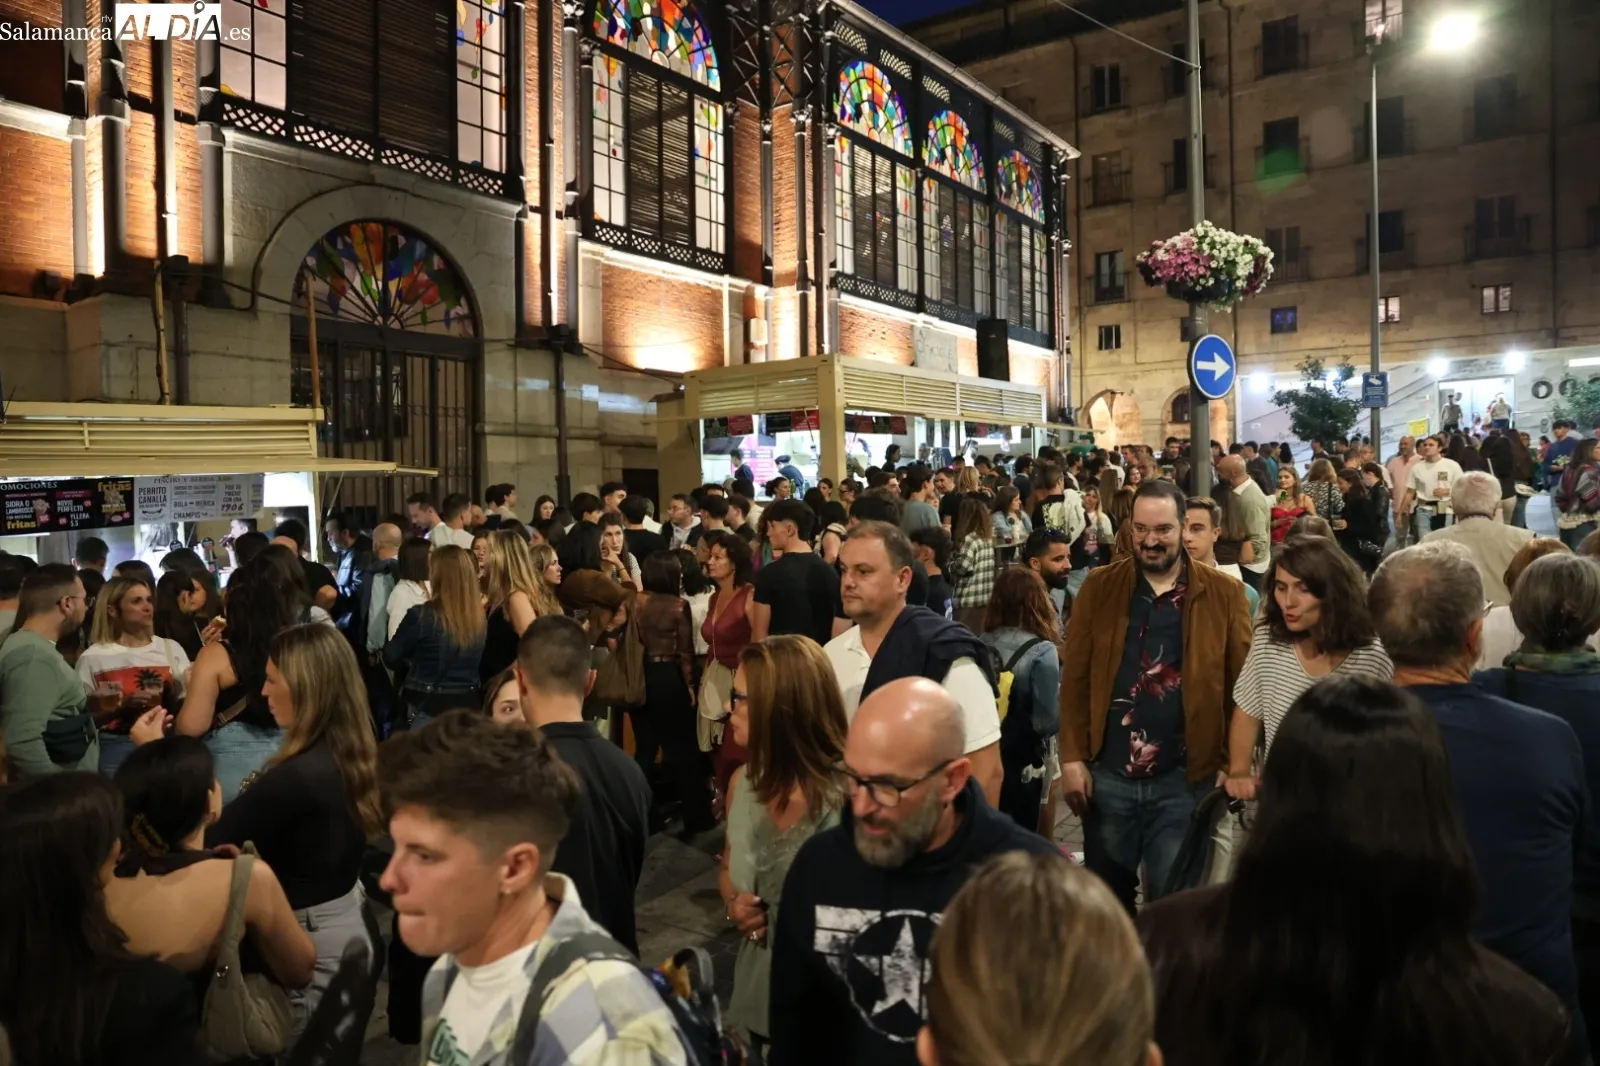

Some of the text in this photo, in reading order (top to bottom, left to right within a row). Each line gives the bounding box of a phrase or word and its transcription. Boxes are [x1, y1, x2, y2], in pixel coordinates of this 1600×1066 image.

[97, 481, 132, 492] fritas
[138, 486, 167, 495] PERRITO
[5, 500, 24, 508] SIDRA
[138, 495, 167, 504] CANALLA
[57, 505, 84, 513] PERFECTO
[221, 503, 244, 512] 1906
[70, 512, 90, 520] YLLERA
[7, 520, 36, 530] fritas
